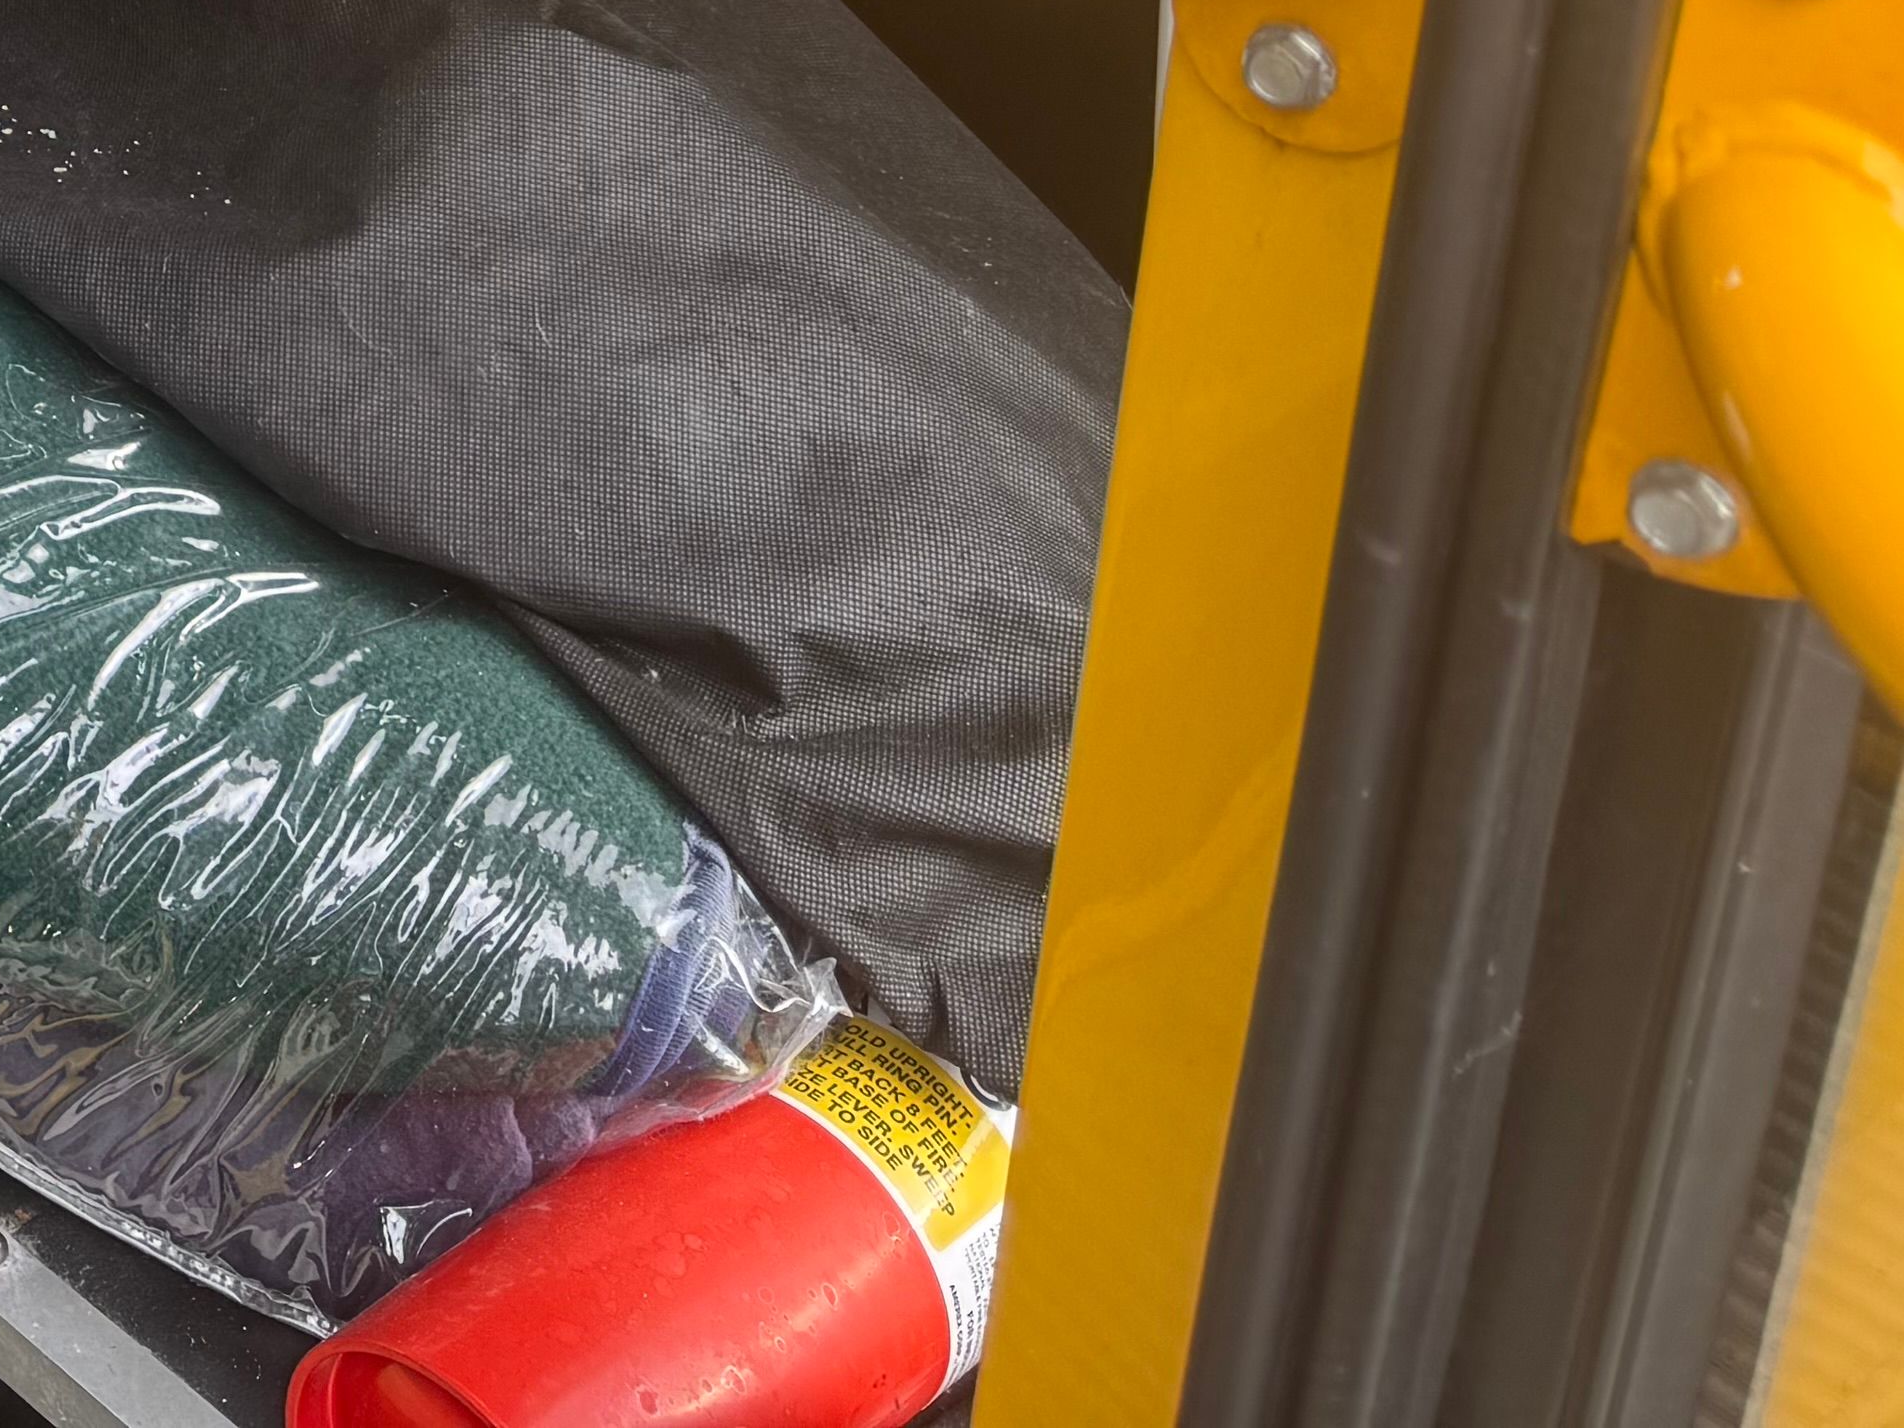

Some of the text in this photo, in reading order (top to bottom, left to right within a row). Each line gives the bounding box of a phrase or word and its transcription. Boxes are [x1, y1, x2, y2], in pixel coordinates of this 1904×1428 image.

[844, 1024, 886, 1048] OLD
[785, 1075, 903, 1171] IDE TO SIDE
[827, 1083, 893, 1143] LEVER.
[832, 1067, 889, 1108] BASE
[889, 1109, 920, 1134] OF
[834, 1034, 867, 1057] ULL
[872, 1055, 923, 1095] RING
[923, 1095, 958, 1136] PIN.
[847, 1059, 906, 1104] BACK
[905, 1103, 921, 1117] 8
[920, 1117, 968, 1178] FEET.
